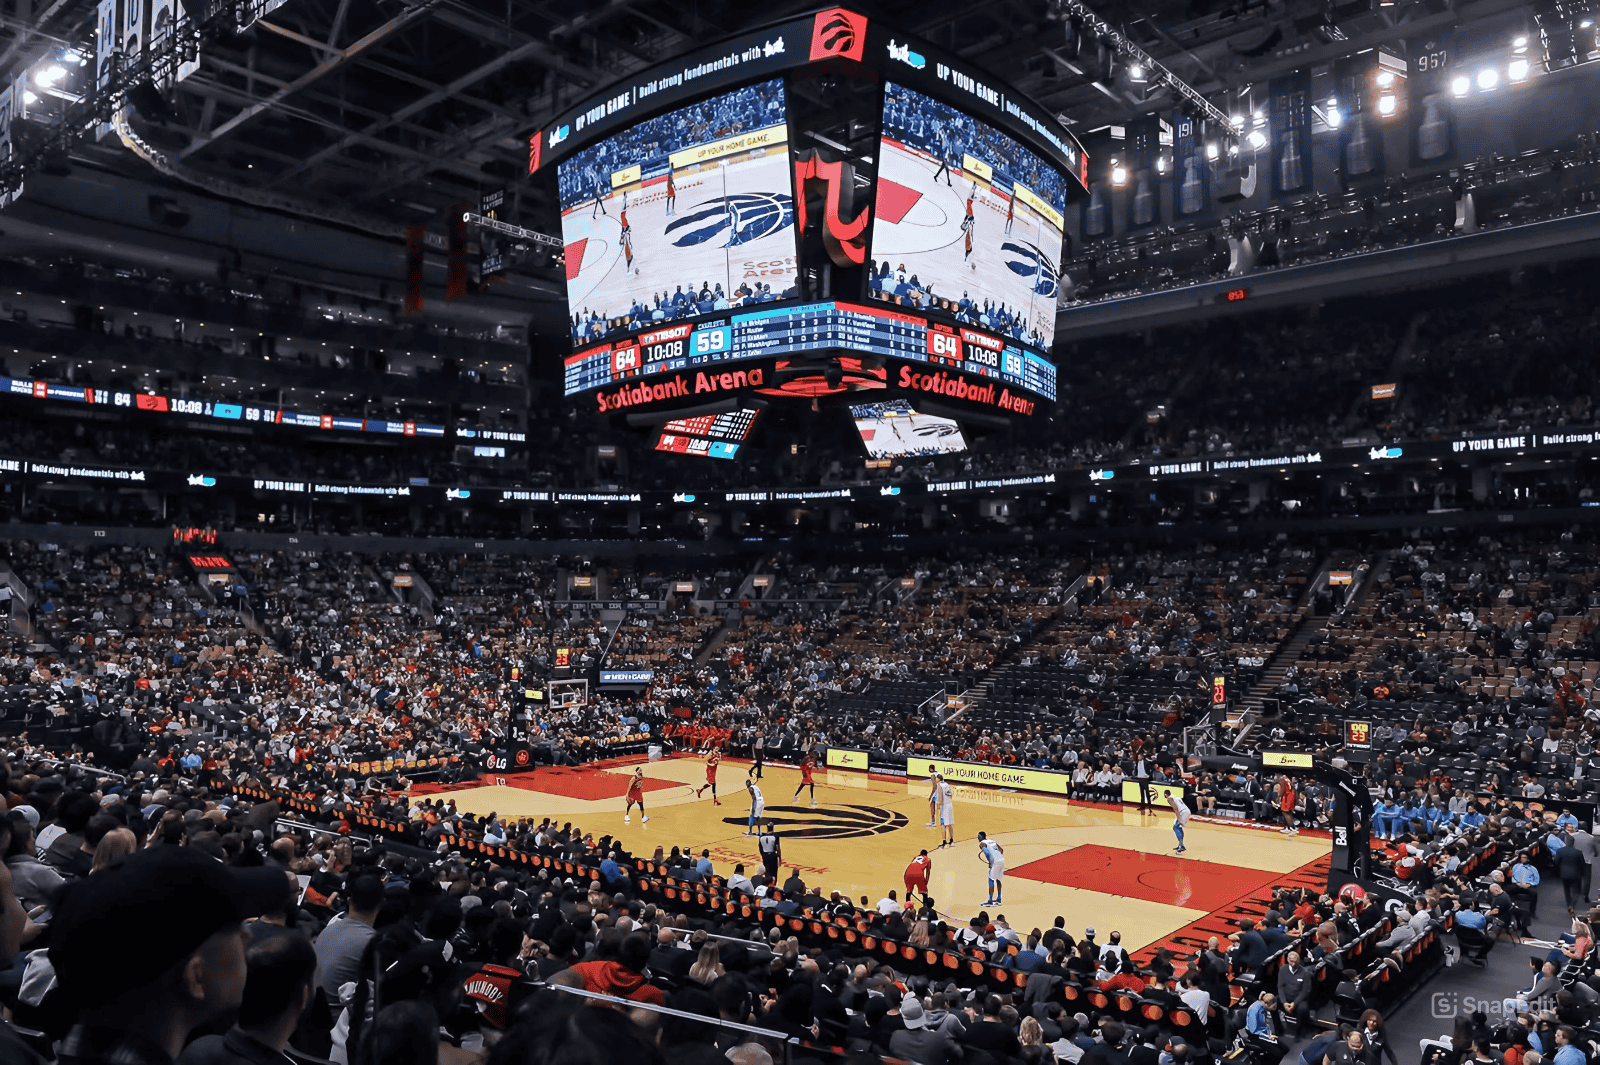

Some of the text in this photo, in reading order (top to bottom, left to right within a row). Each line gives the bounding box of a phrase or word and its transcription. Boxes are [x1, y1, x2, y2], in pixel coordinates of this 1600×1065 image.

[576, 112, 586, 131] UP
[586, 102, 605, 125] YOUR
[607, 92, 630, 114] GAME
[639, 84, 657, 98] Build
[658, 73, 682, 90] strong
[684, 54, 739, 81] fundamentals
[742, 46, 761, 62] with
[937, 63, 949, 80] UP
[952, 70, 974, 94] YOUR
[976, 82, 999, 106] GAME
[707, 146, 725, 155] YOUR
[726, 141, 744, 151] HOME
[615, 348, 636, 370] 64
[647, 340, 683, 362] 10:08
[697, 330, 724, 352] 59
[933, 335, 1020, 374] 64 10:08 59
[596, 368, 763, 414] Scotiabank Arena
[898, 366, 996, 405] Scotiabank
[998, 389, 1034, 415] Arena
[171, 399, 202, 414] 10:08
[246, 408, 259, 420] 59
[1452, 442, 1466, 452] UP
[1468, 439, 1495, 451] YOUR
[1497, 437, 1526, 449] GAME
[1543, 434, 1564, 445] Build
[1566, 433, 1592, 443] strong
[1150, 466, 1159, 475] UP
[1161, 464, 1179, 474] YOUR
[1181, 463, 1201, 473] GAME
[1353, 731, 1365, 742] 23
[496, 758, 506, 769] LG
[944, 767, 1026, 784] UP YOUR HOME GAME
[1335, 826, 1347, 846] Bell
